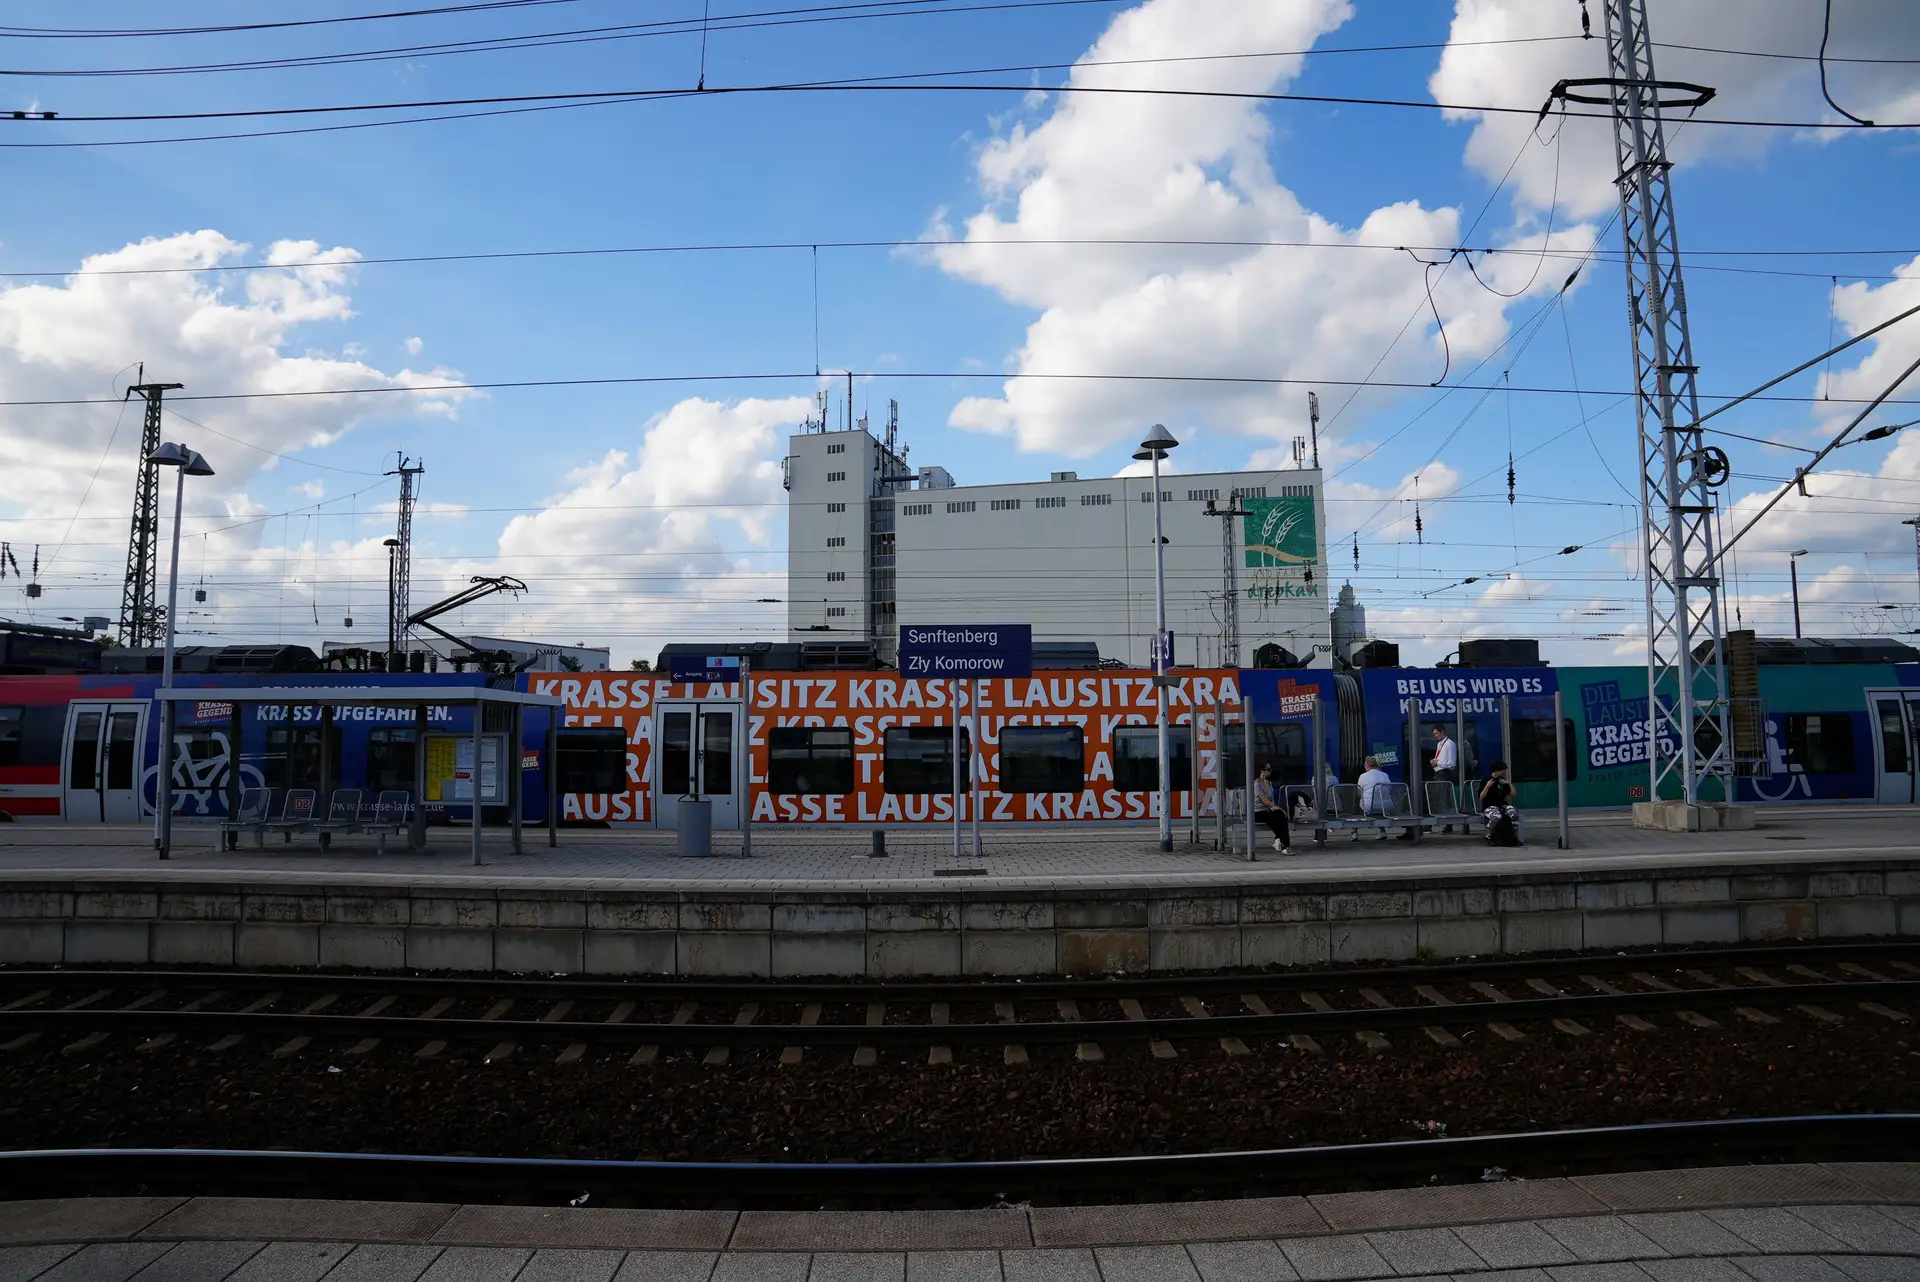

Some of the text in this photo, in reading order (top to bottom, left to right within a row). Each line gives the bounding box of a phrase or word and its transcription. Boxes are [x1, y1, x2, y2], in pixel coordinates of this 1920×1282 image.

[1246, 569, 1318, 577] LANDHANDL
[908, 629, 998, 646] Senftenberg
[1164, 634, 1170, 660] 3
[908, 656, 1005, 673] Zły Komorow
[535, 679, 672, 708] KRASSE
[848, 679, 992, 708] KRASSE
[1004, 678, 1157, 708] LAUSITZ
[1168, 677, 1240, 706] KRA
[1397, 677, 1544, 695] BEI UNS WIRD ES
[1583, 684, 1618, 705] DIE
[1281, 693, 1317, 705] KRASSE
[1400, 697, 1500, 714] KRASS GUT.
[257, 705, 314, 721] KRASS
[1587, 699, 1665, 725] LAUSIZ
[1589, 718, 1668, 746] KRASSE
[1629, 787, 1643, 797] DB
[296, 799, 310, 809] DB
[563, 791, 652, 820] AUSI
[857, 791, 1014, 821] LAUSITZ
[1025, 789, 1161, 820] KRASSE
